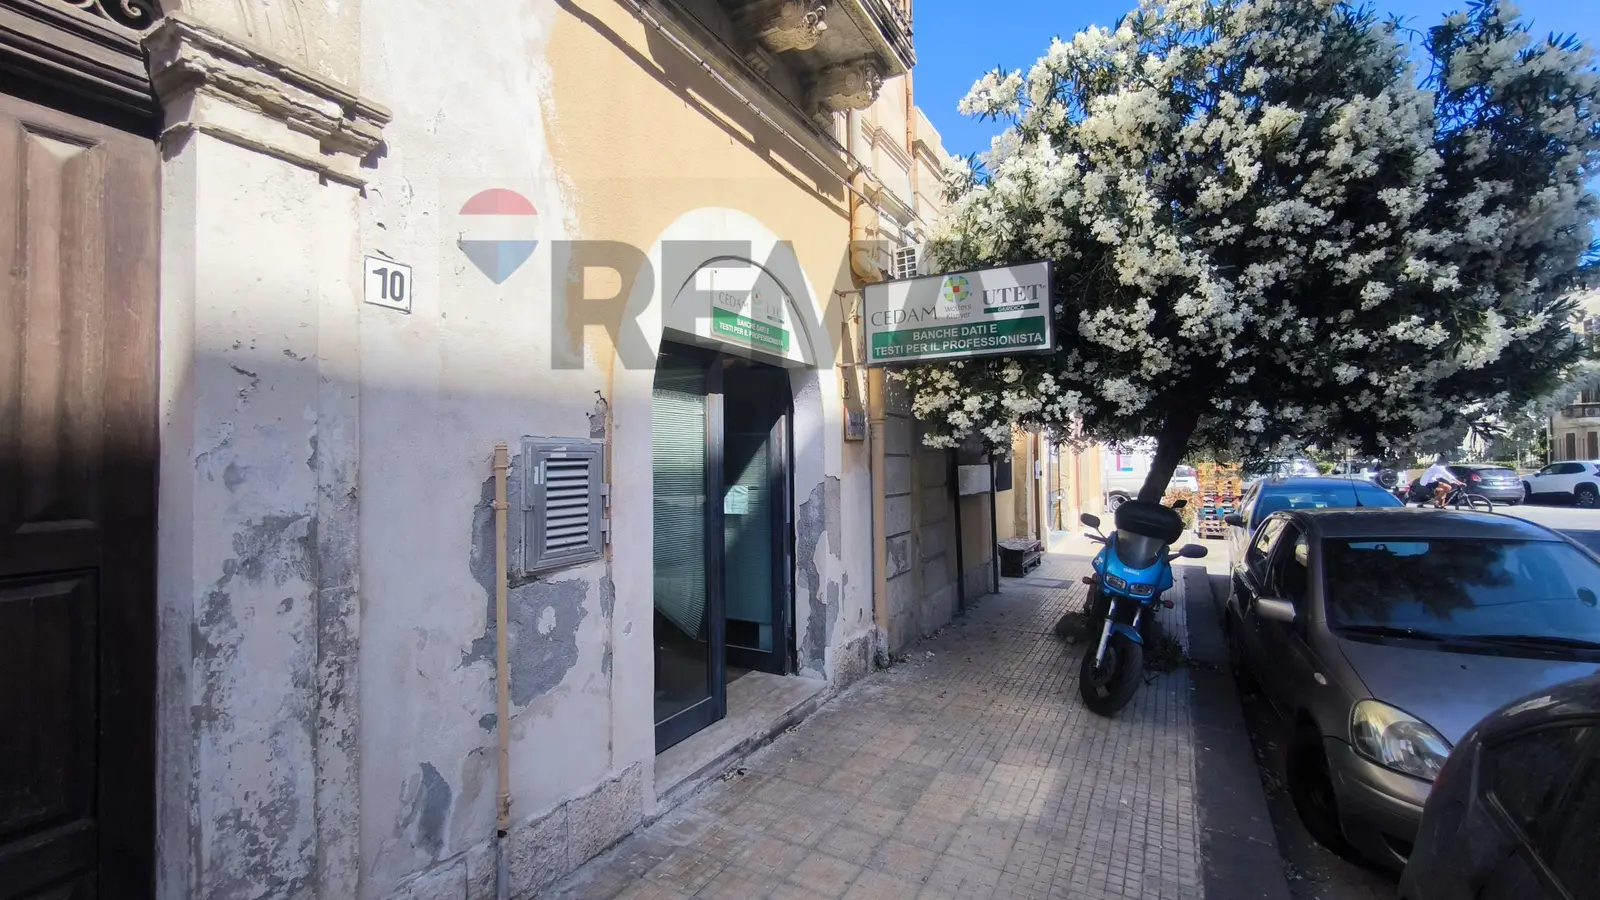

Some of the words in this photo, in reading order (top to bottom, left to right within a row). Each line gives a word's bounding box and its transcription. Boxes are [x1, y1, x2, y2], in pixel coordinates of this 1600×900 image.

[372, 267, 404, 302] 10
[719, 292, 749, 312] CEDAM
[982, 284, 1042, 306] UTET
[871, 307, 937, 327] CEDAM
[944, 303, 972, 312] Wolters
[719, 322, 733, 332] TESTI
[734, 325, 743, 336] PER
[912, 327, 958, 341] BANCHE
[961, 325, 987, 336] DATI
[990, 324, 998, 333] E
[874, 345, 903, 356] TESTI
[906, 343, 927, 354] PER
[930, 342, 940, 351] IL
[943, 332, 1043, 350] PROFESSIONISTA
